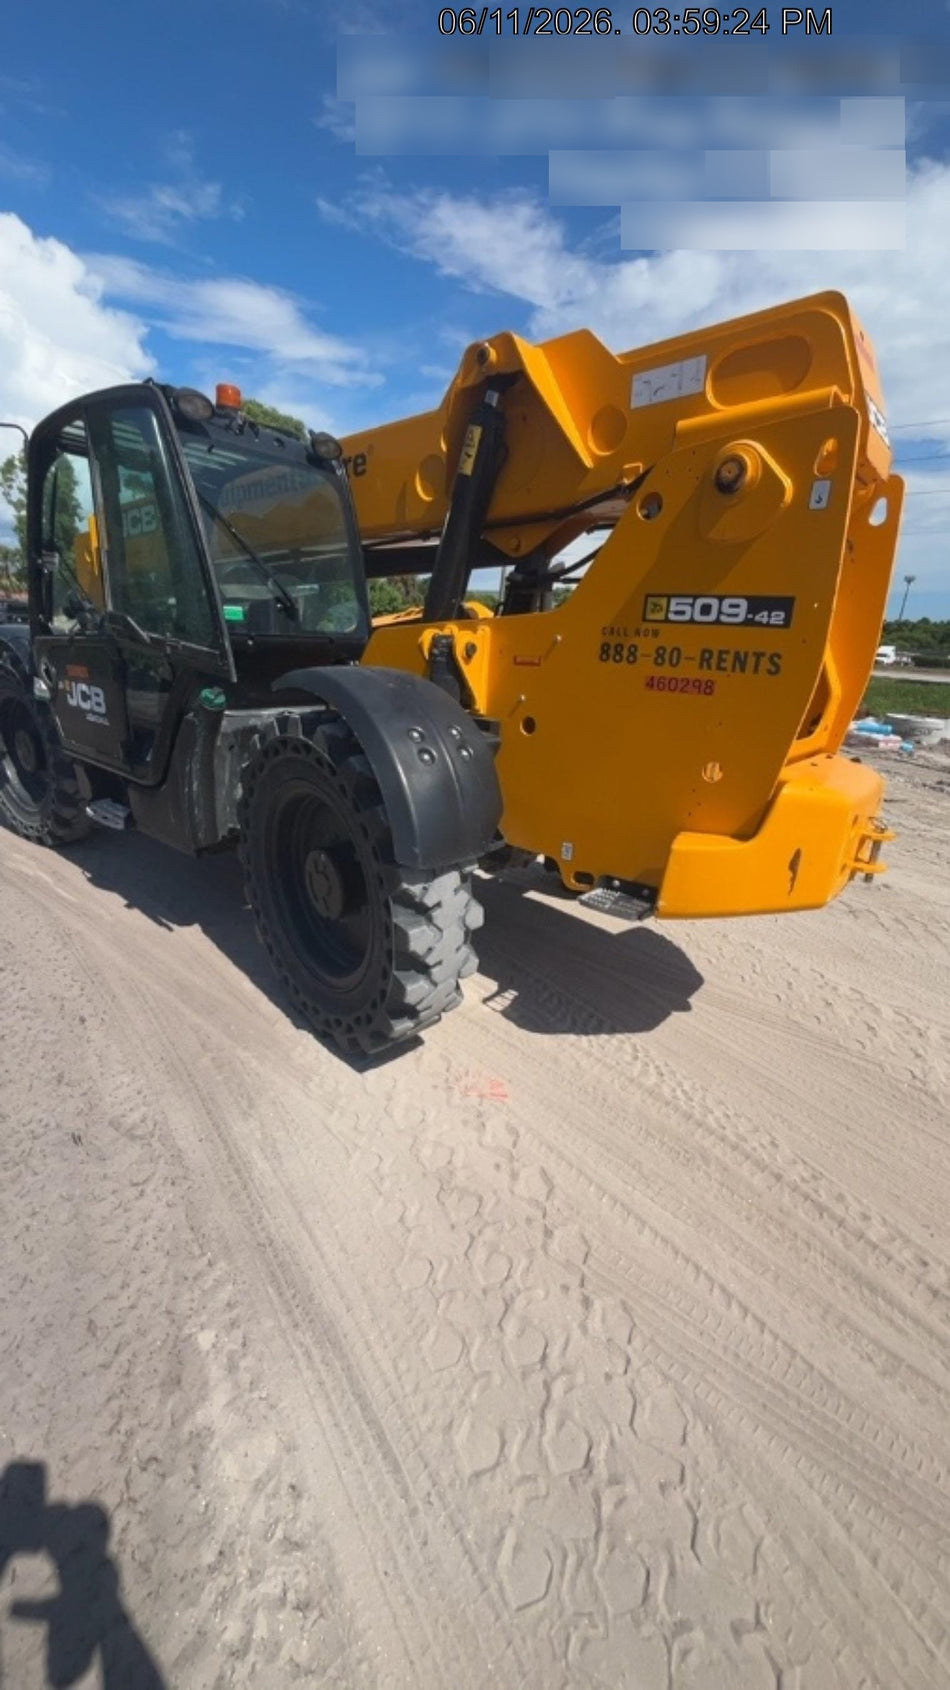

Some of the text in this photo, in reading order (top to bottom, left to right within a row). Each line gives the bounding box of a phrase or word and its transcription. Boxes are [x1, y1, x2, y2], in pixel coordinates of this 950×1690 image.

[602, 626, 660, 639] CALL NOW
[599, 641, 782, 676] 888-80-RENTS
[66, 680, 106, 714] JCB
[645, 675, 716, 696] 460298
